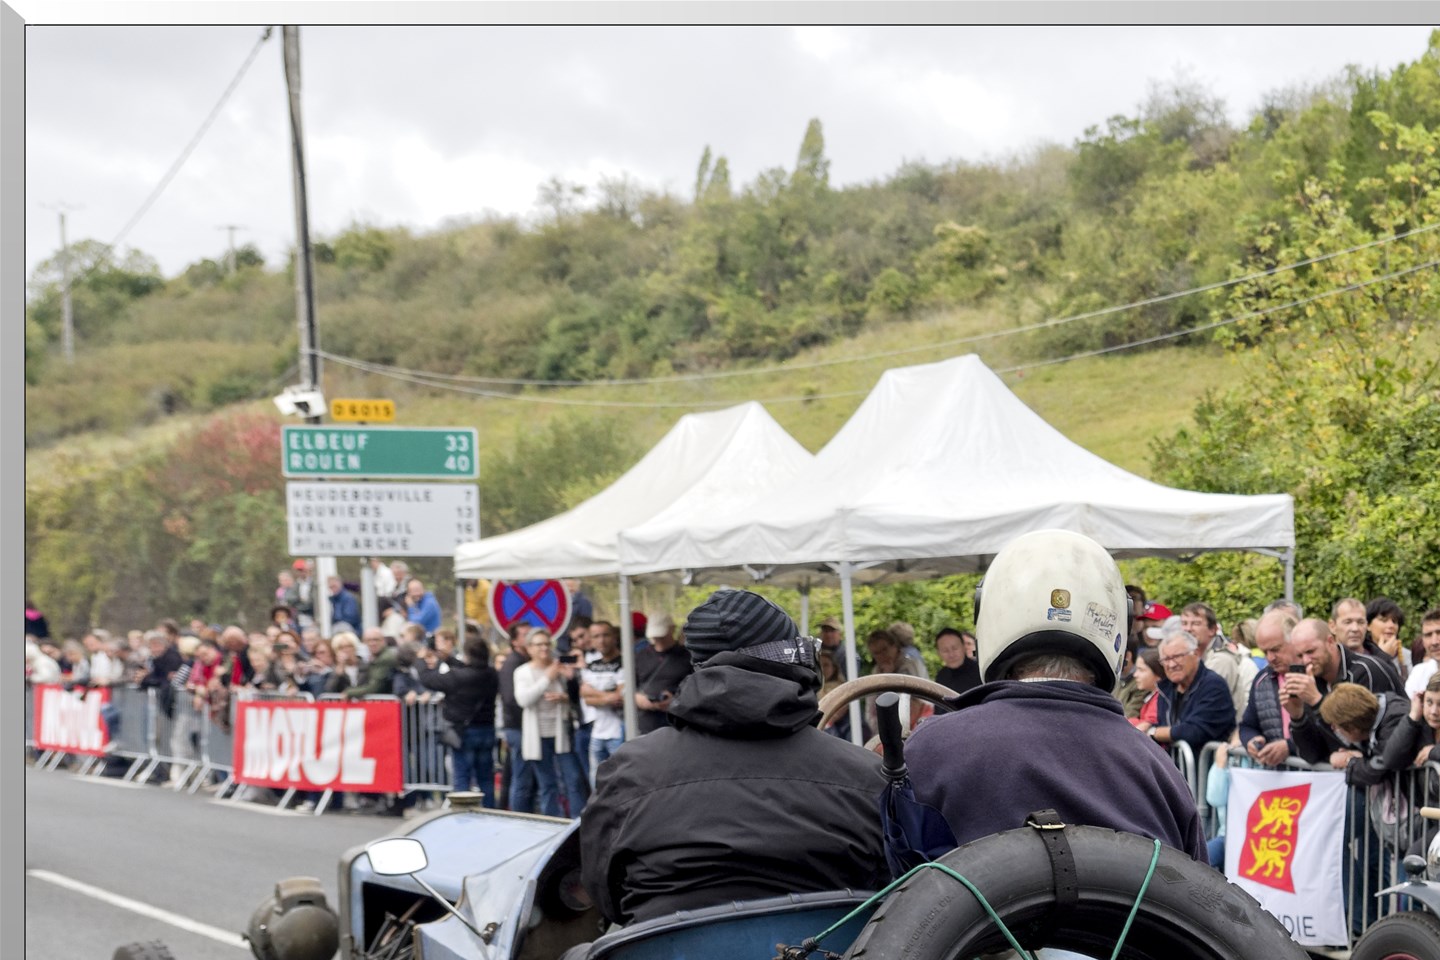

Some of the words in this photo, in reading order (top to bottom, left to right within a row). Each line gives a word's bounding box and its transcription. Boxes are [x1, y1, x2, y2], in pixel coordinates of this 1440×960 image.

[290, 432, 369, 450] ELBEUF
[445, 434, 470, 452] 33
[290, 452, 361, 471] ROUEN
[445, 455, 470, 472] 40
[293, 506, 383, 518] LOUVIERS
[295, 522, 326, 534] VAL
[359, 522, 414, 534] REUIL
[243, 706, 377, 785] MOTUL
